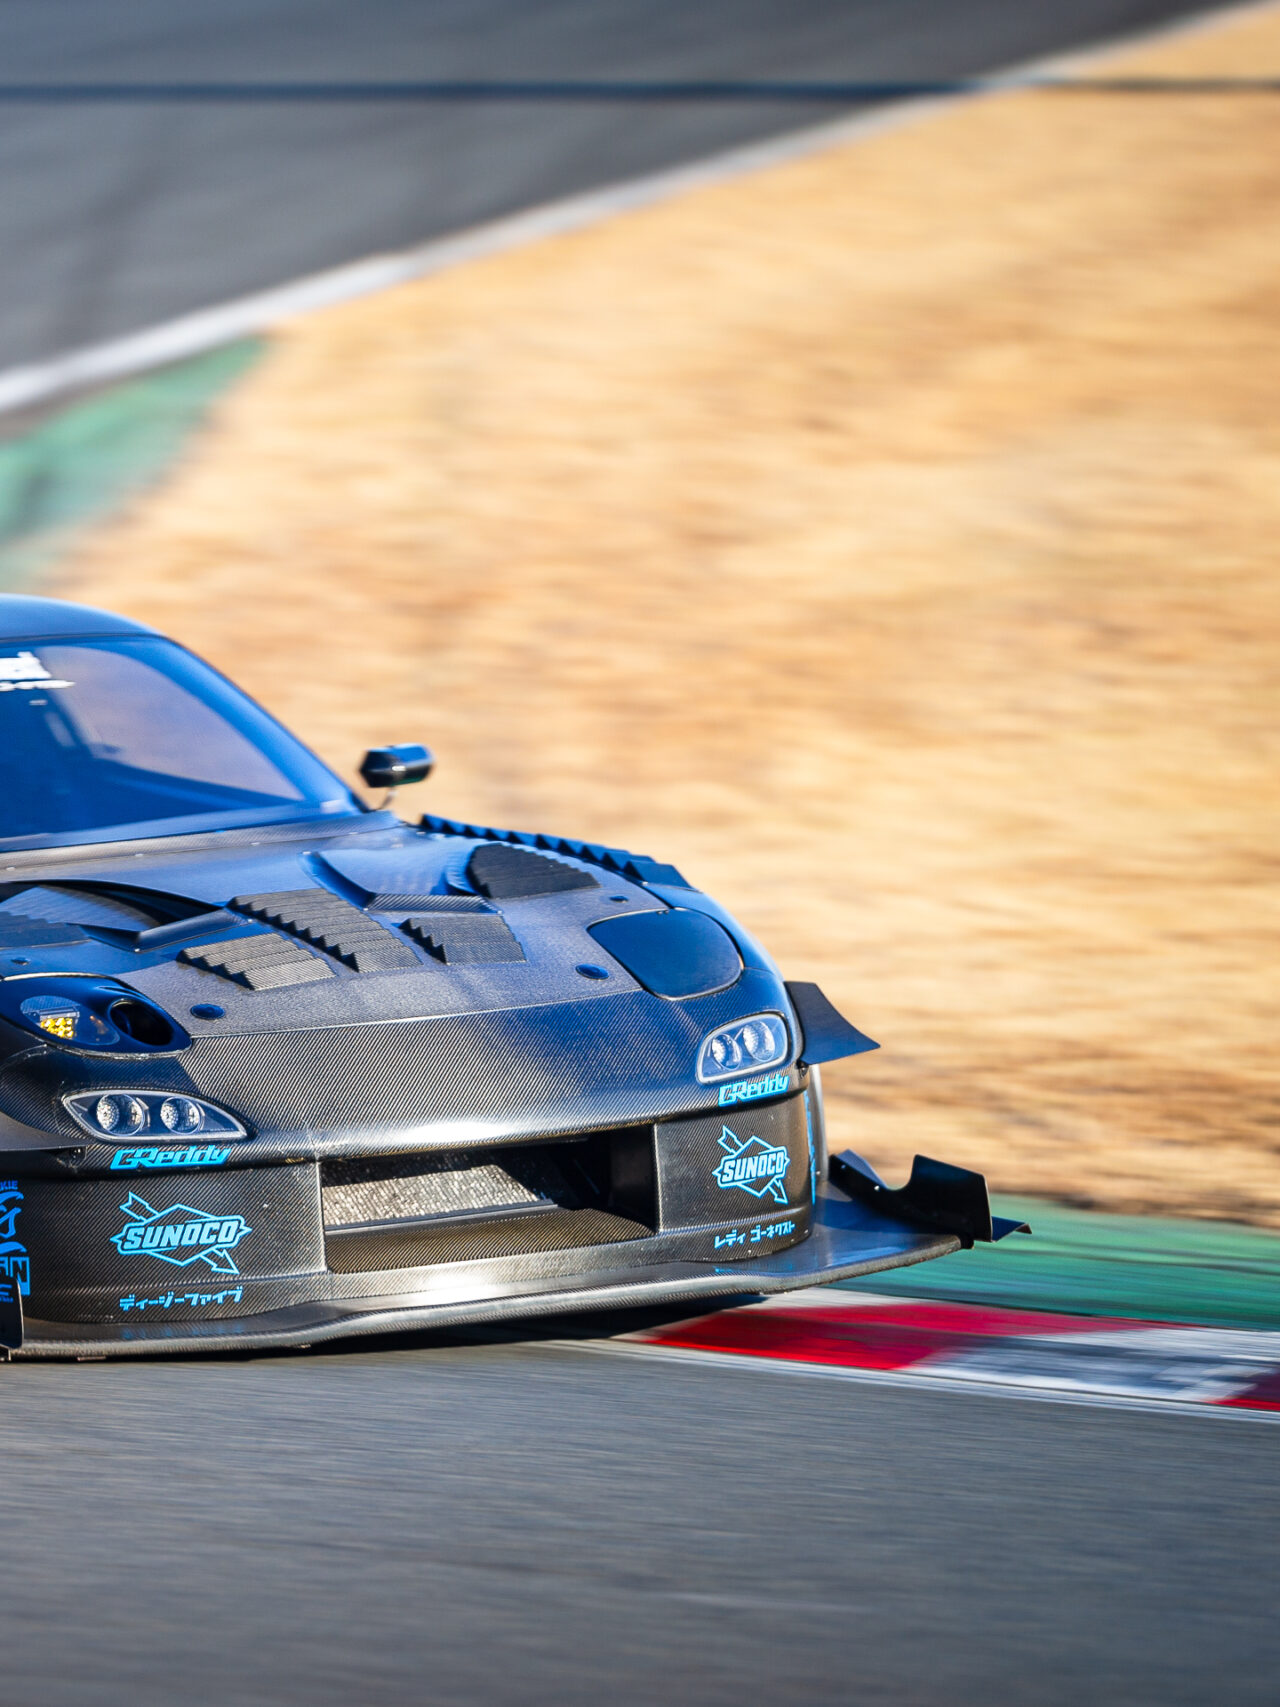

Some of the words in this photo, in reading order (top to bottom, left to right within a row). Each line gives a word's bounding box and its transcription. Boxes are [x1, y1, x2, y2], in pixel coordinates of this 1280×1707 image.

[718, 1074, 789, 1107] GReddy
[110, 1145, 231, 1170] GReddy
[721, 1151, 784, 1183] SUNOCO
[123, 1220, 238, 1250] SUNOCO
[714, 1229, 747, 1249] レディ
[750, 1220, 795, 1243] ゴーネクスト
[119, 1285, 243, 1312] ディージーファイブ
